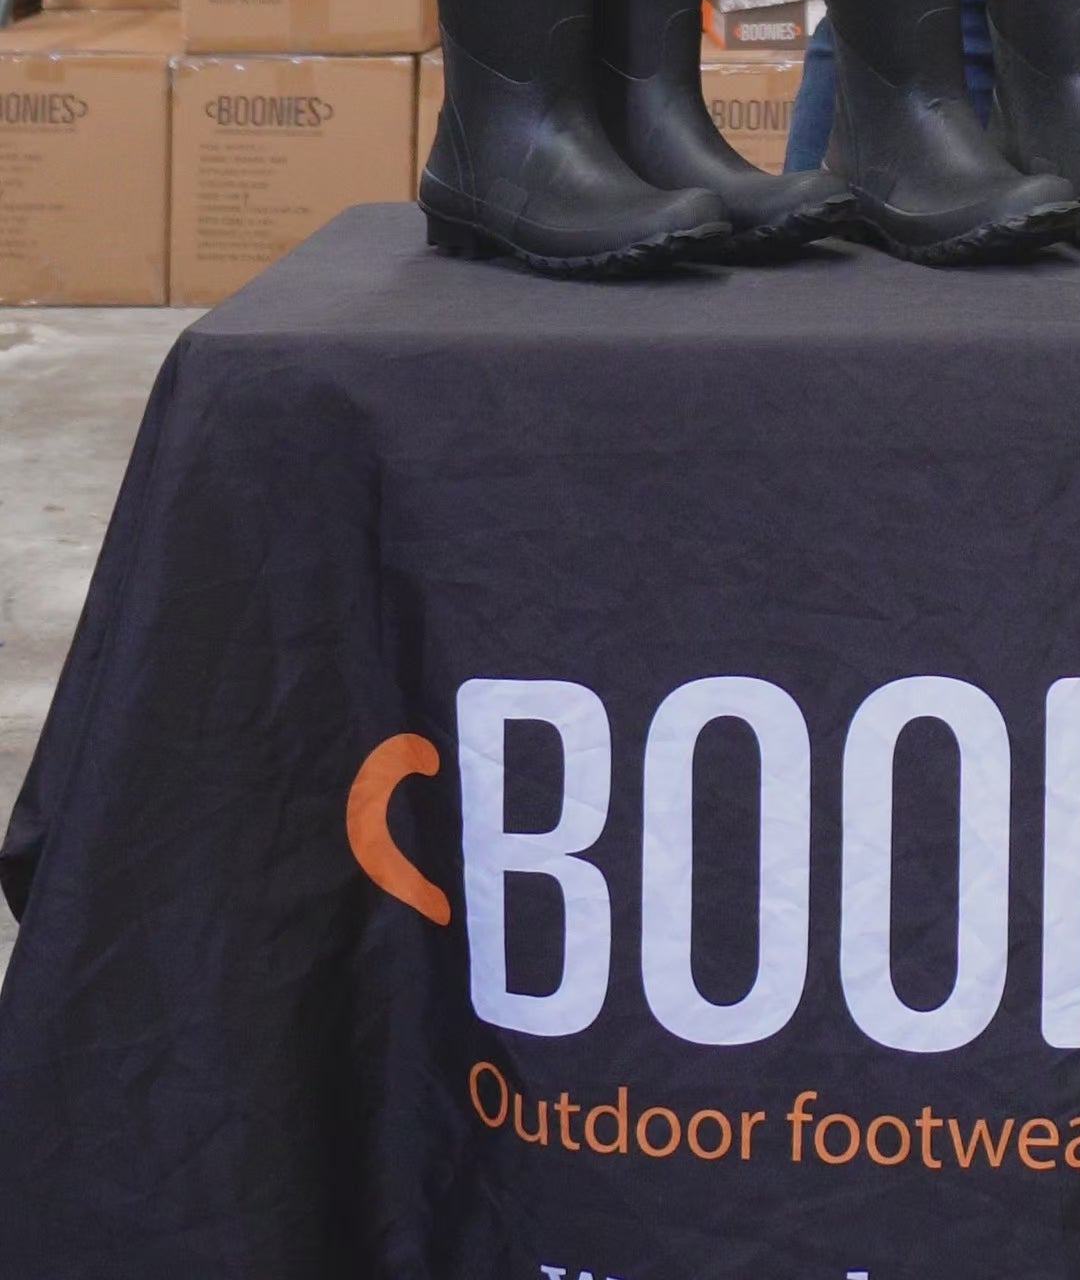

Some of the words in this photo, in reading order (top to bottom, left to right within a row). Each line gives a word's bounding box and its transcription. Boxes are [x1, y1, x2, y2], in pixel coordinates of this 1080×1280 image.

[741, 22, 795, 41] BOONIES
[217, 95, 322, 128] BOONIES
[468, 1061, 764, 1164] Outdoor
